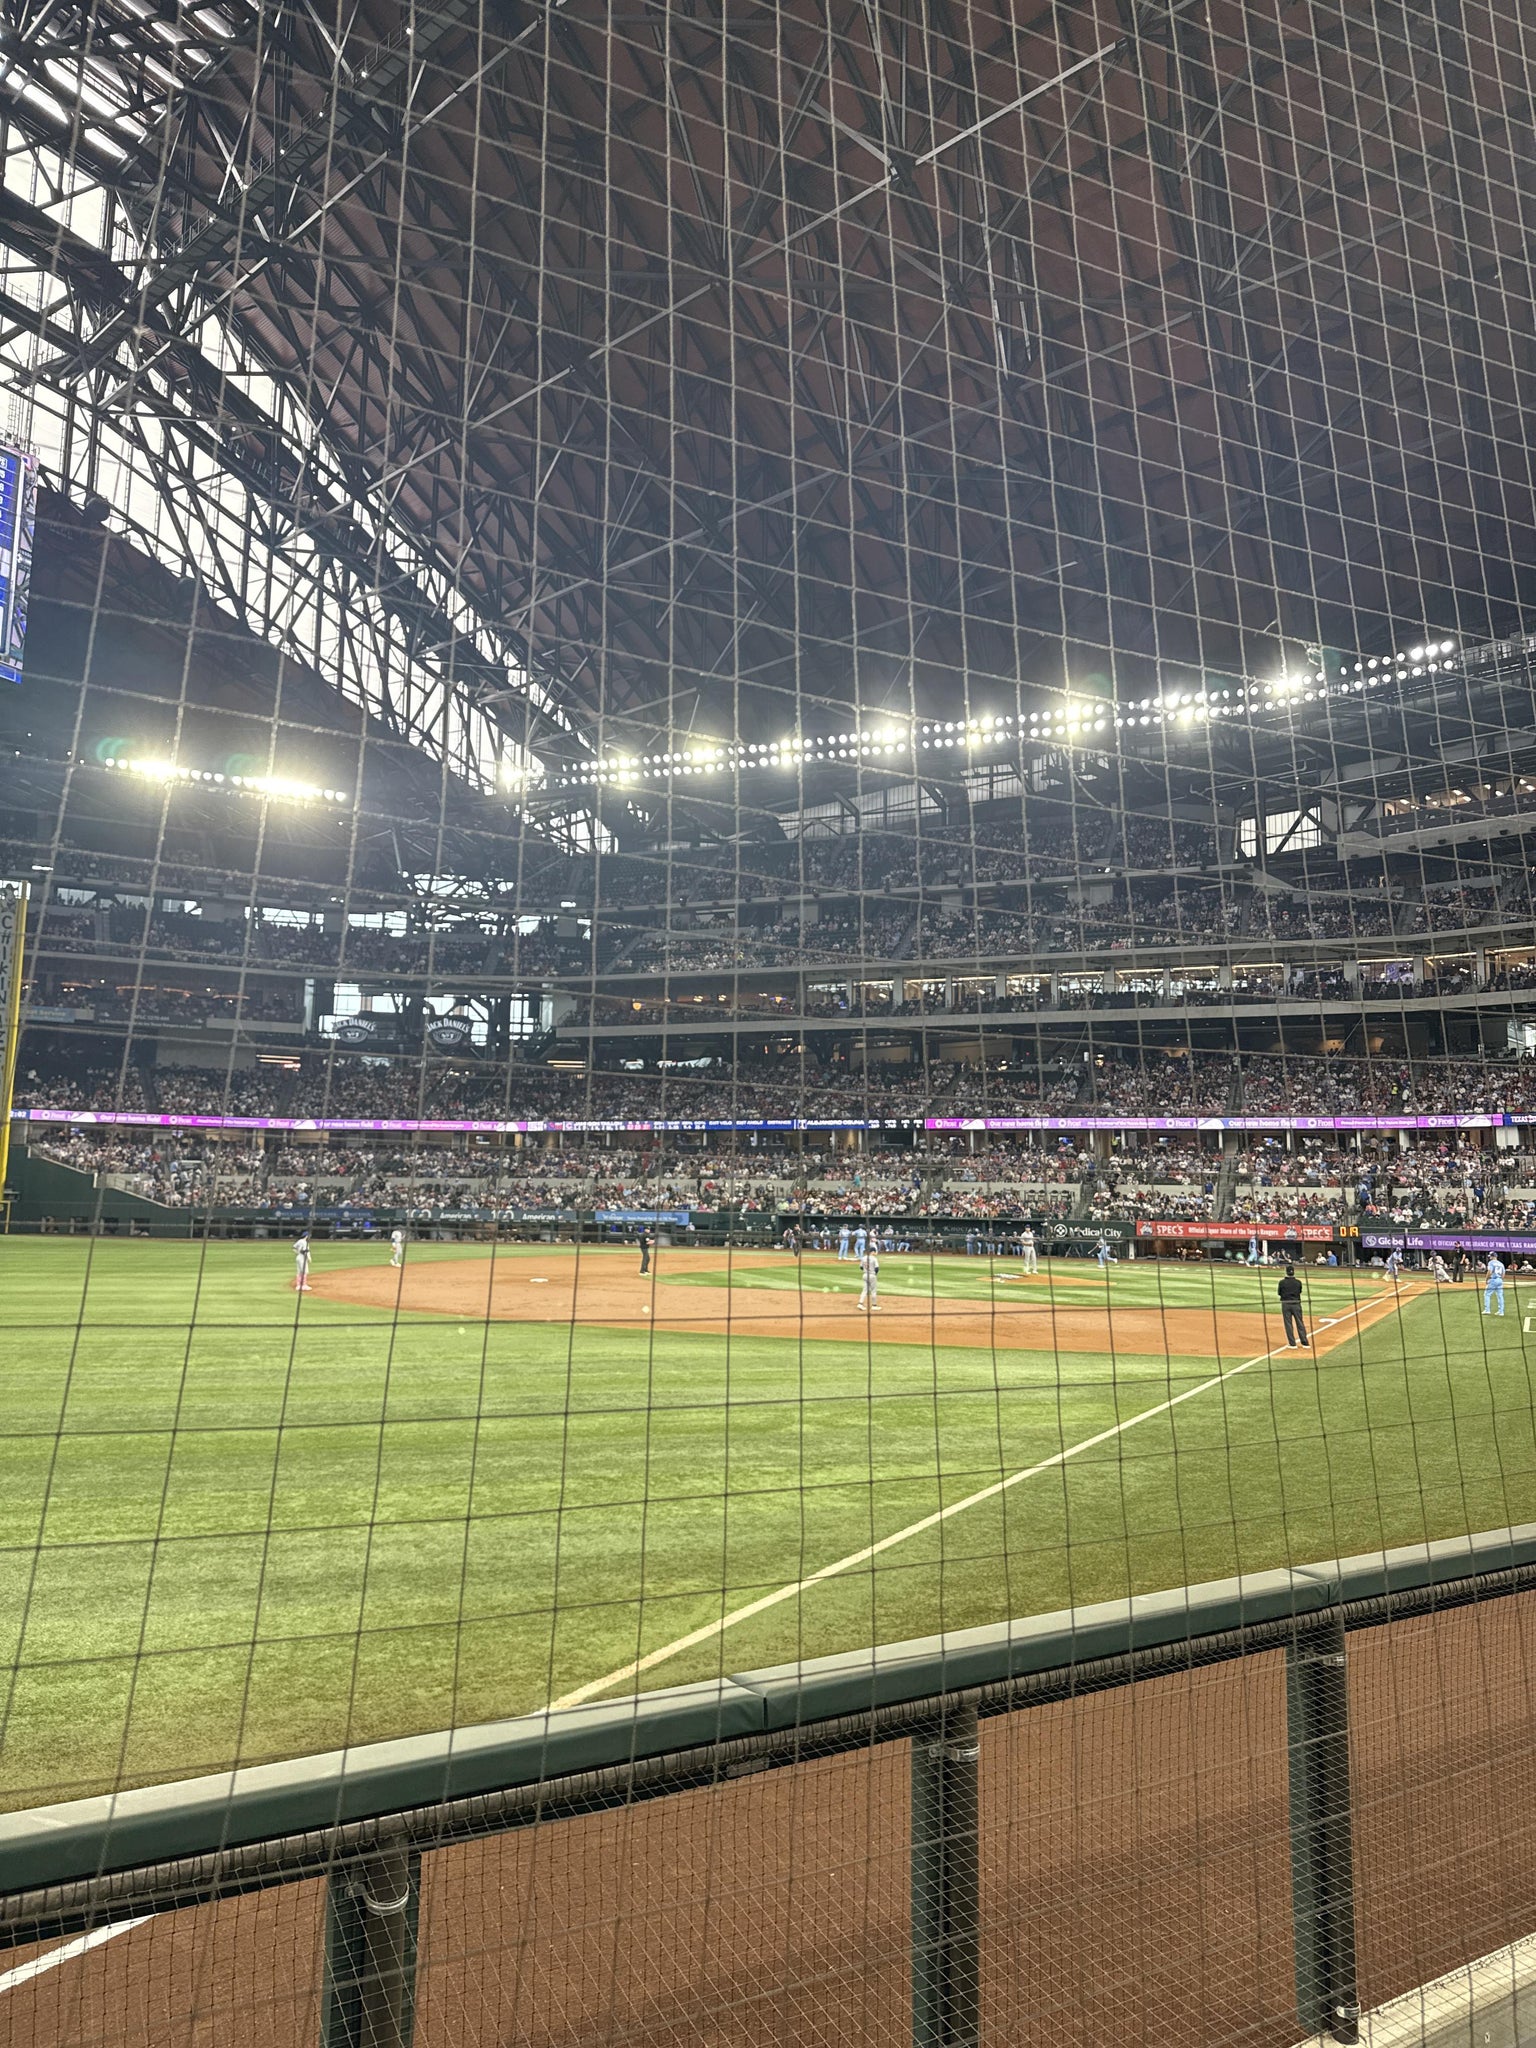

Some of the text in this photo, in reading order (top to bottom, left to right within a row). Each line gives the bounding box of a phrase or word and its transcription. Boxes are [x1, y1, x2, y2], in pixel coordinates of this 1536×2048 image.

[425, 1018, 470, 1033] JACK DANIEL'S
[1259, 1119, 1279, 1127] home
[1280, 1119, 1297, 1127] field
[1317, 1119, 1334, 1127] Frost
[1069, 1227, 1123, 1239] Mdical City
[1156, 1224, 1184, 1235] SPEC'S
[1378, 1237, 1424, 1246] Globe Life
